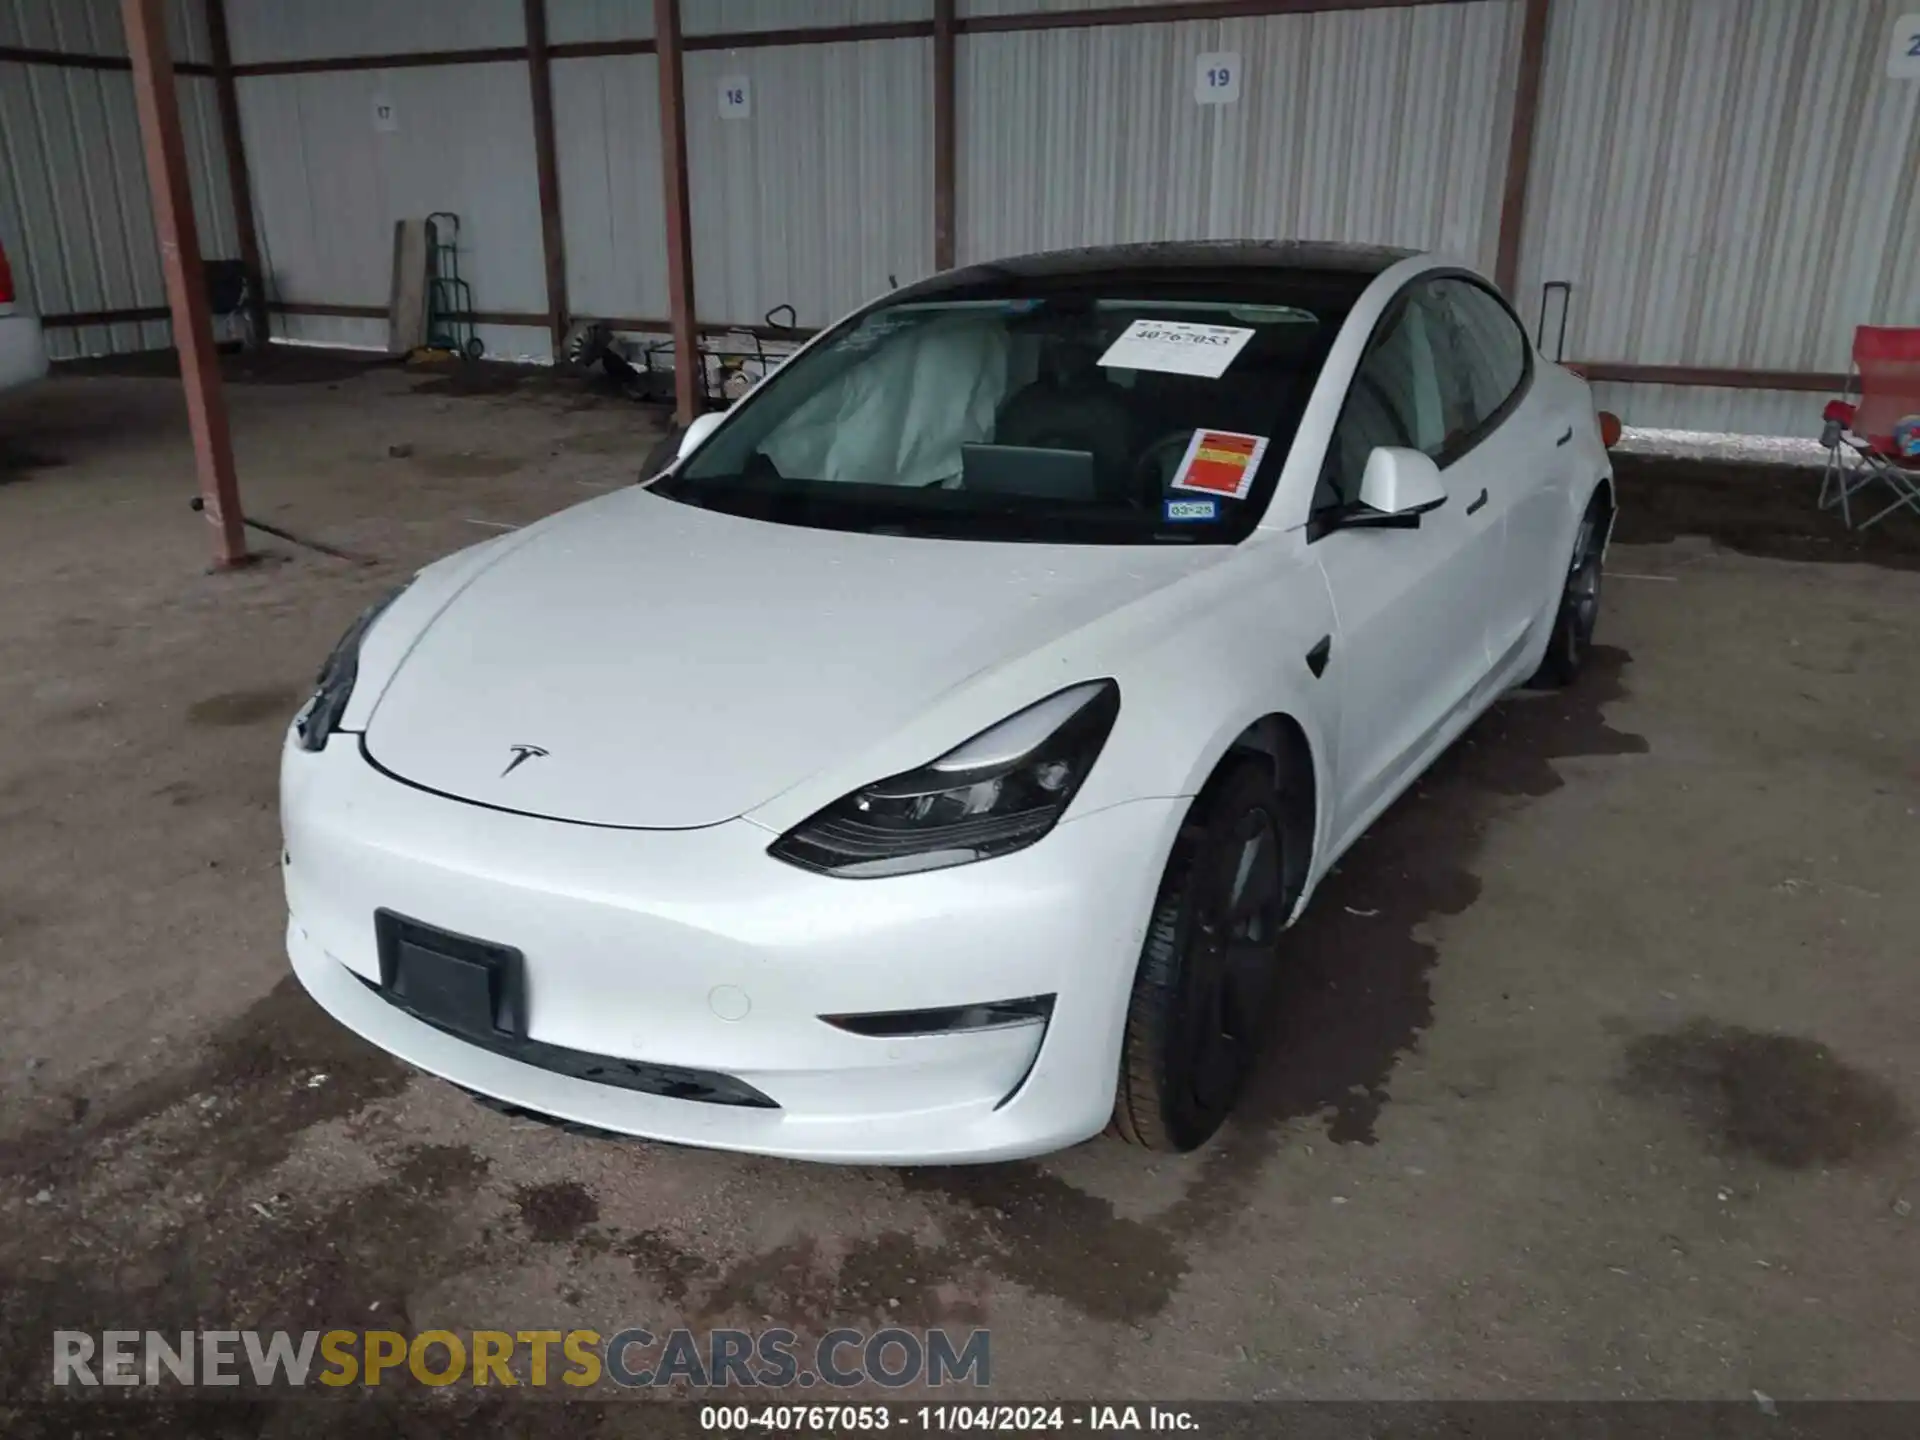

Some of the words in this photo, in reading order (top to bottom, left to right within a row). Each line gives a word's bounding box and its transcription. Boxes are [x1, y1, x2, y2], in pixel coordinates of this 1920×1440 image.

[1207, 68, 1230, 87] 19
[727, 88, 744, 106] 18
[1136, 330, 1232, 347] 40767053
